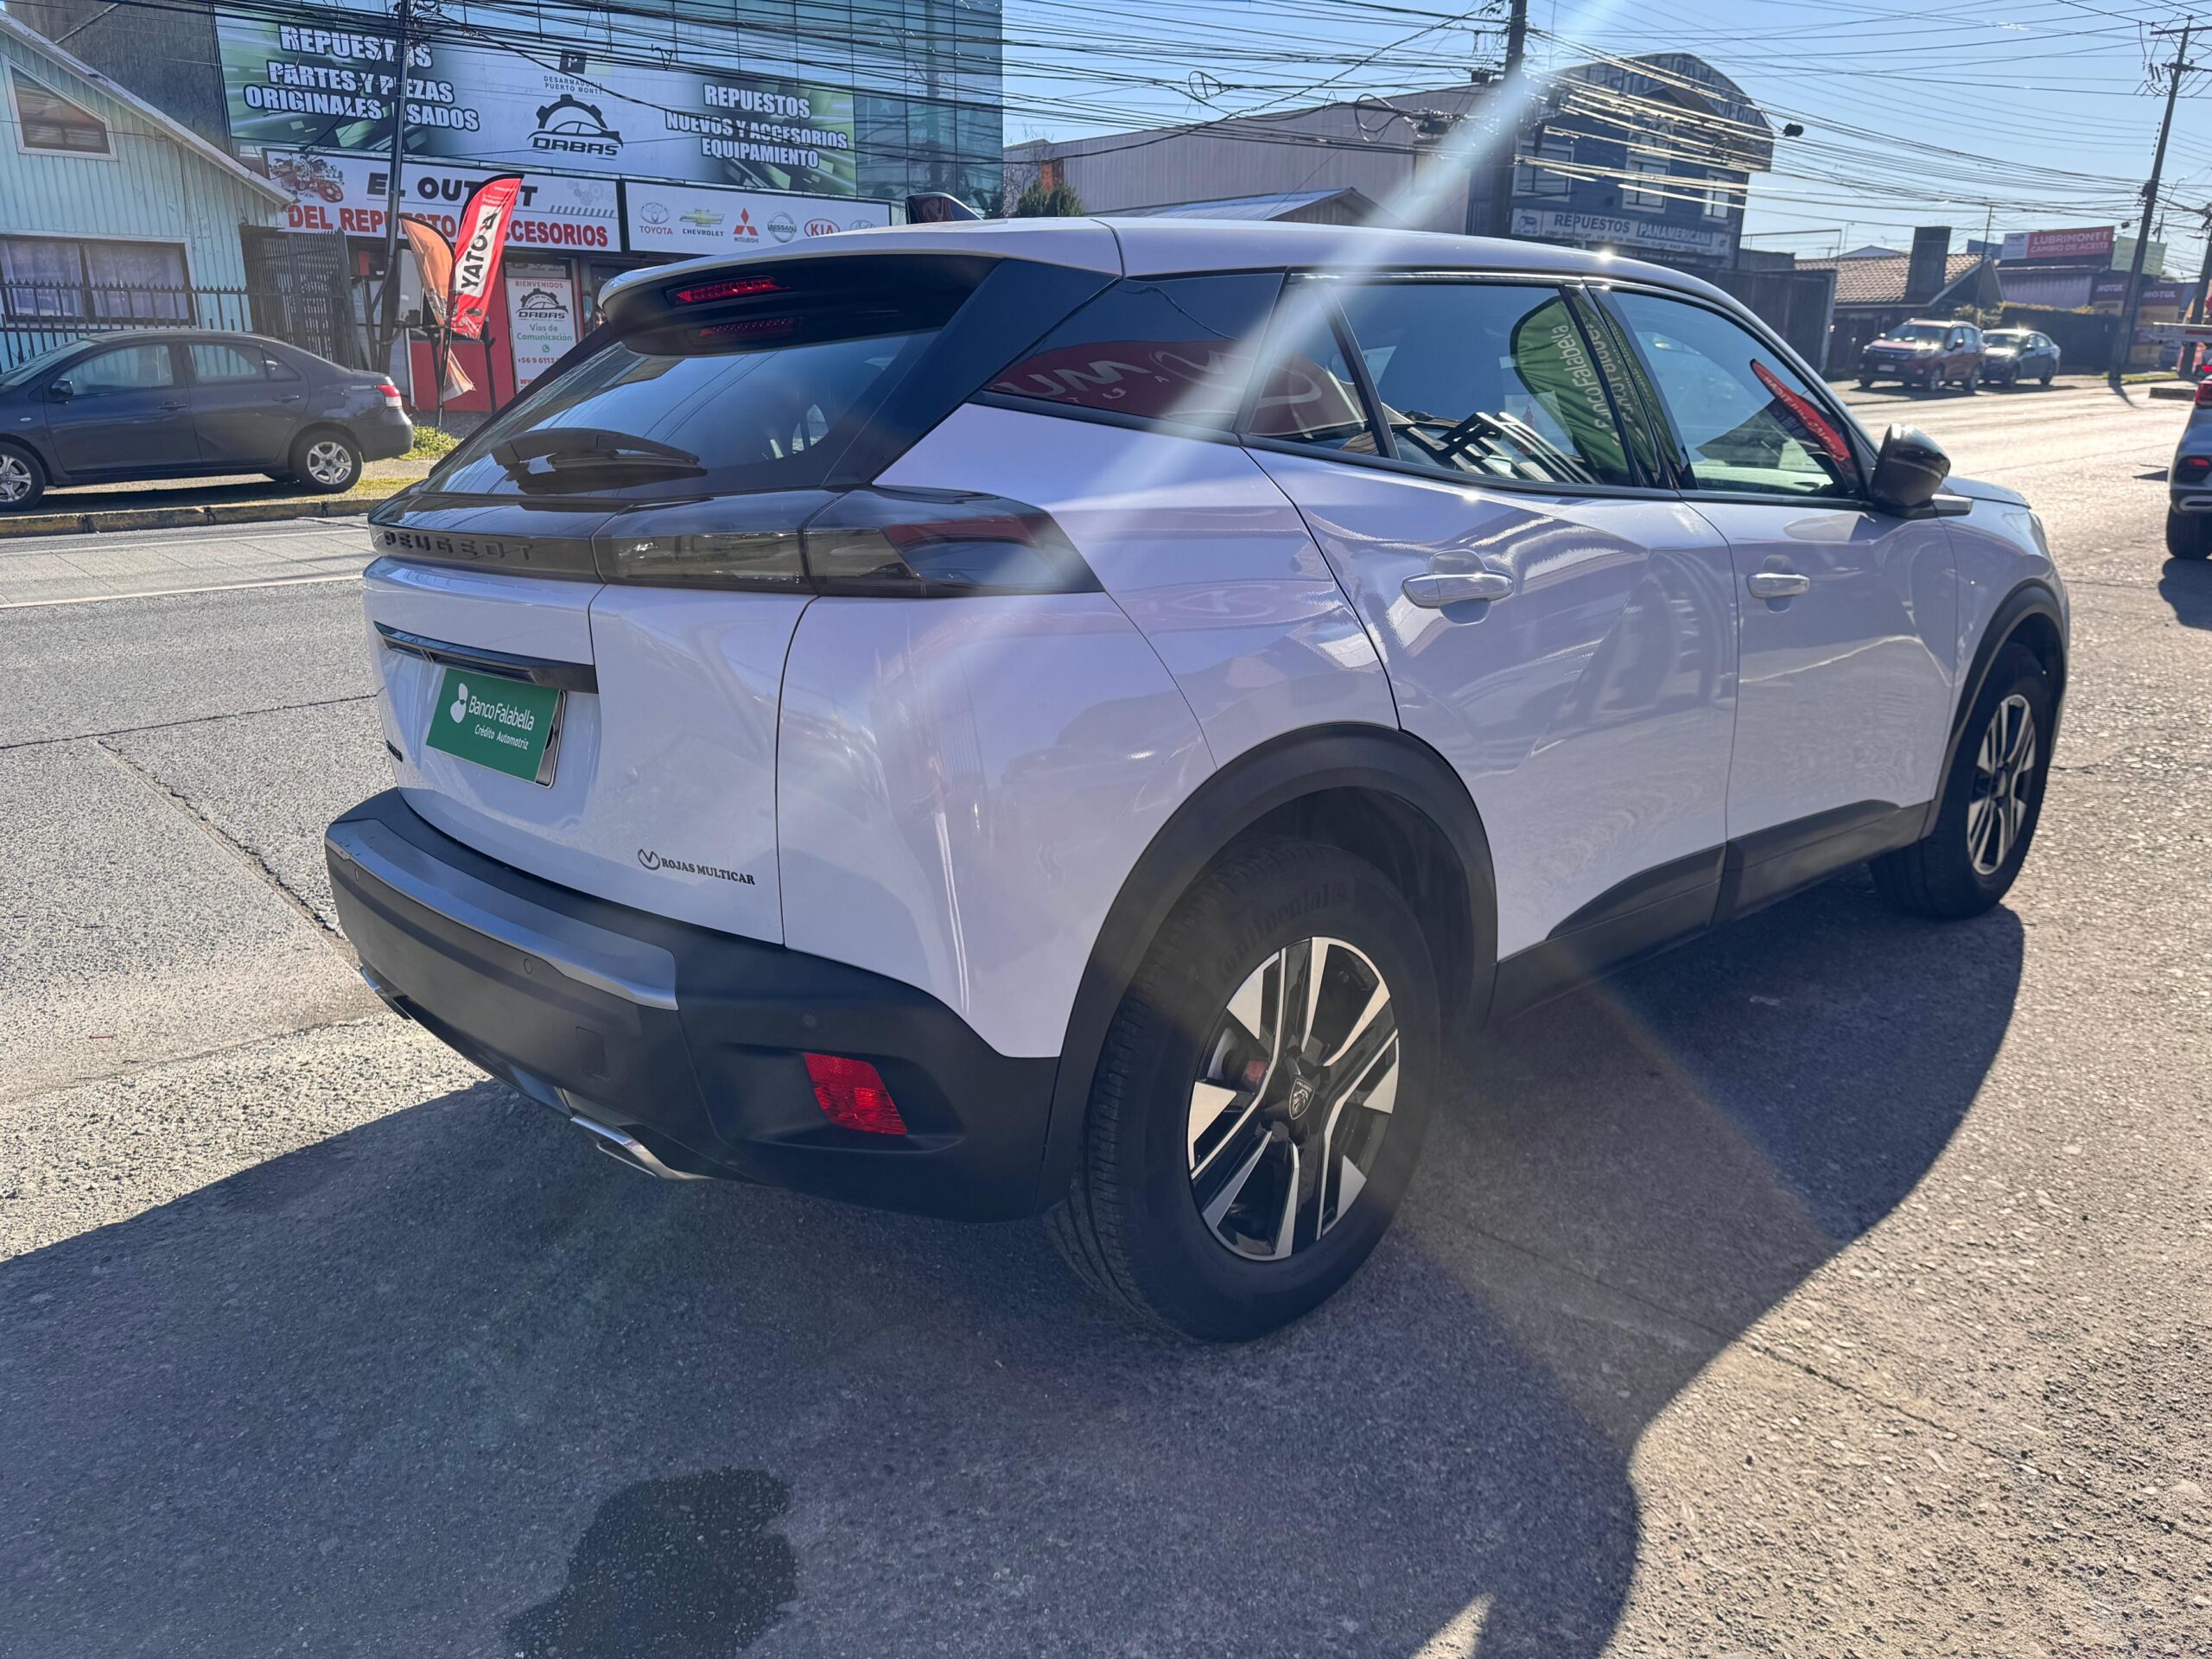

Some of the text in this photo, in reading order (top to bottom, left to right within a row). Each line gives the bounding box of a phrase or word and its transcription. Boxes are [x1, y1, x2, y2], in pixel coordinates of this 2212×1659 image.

[268, 62, 356, 92] PARTES
[360, 73, 374, 93] Y
[545, 83, 575, 92] PUERTO
[245, 86, 382, 119] ORIGINALES
[703, 84, 810, 118] REPUESTOS
[665, 110, 848, 149] NUEVOS Y ACCESORIOS
[532, 137, 619, 156] DABAS
[702, 138, 819, 168] EQUIPAMIENTO
[288, 205, 334, 231] DEL
[640, 226, 673, 236] TOYOTA
[810, 223, 834, 236] KIA
[1554, 213, 1630, 233] REPUESTOS
[1640, 222, 1713, 245] PANAMERICANA
[683, 229, 724, 238] CHEVROLET
[2031, 245, 2063, 253] CAMBIO
[384, 531, 533, 561] PEUGEOT
[475, 723, 529, 750] Crédito Automotriz
[661, 857, 755, 885] ROJAS MULTICAR
